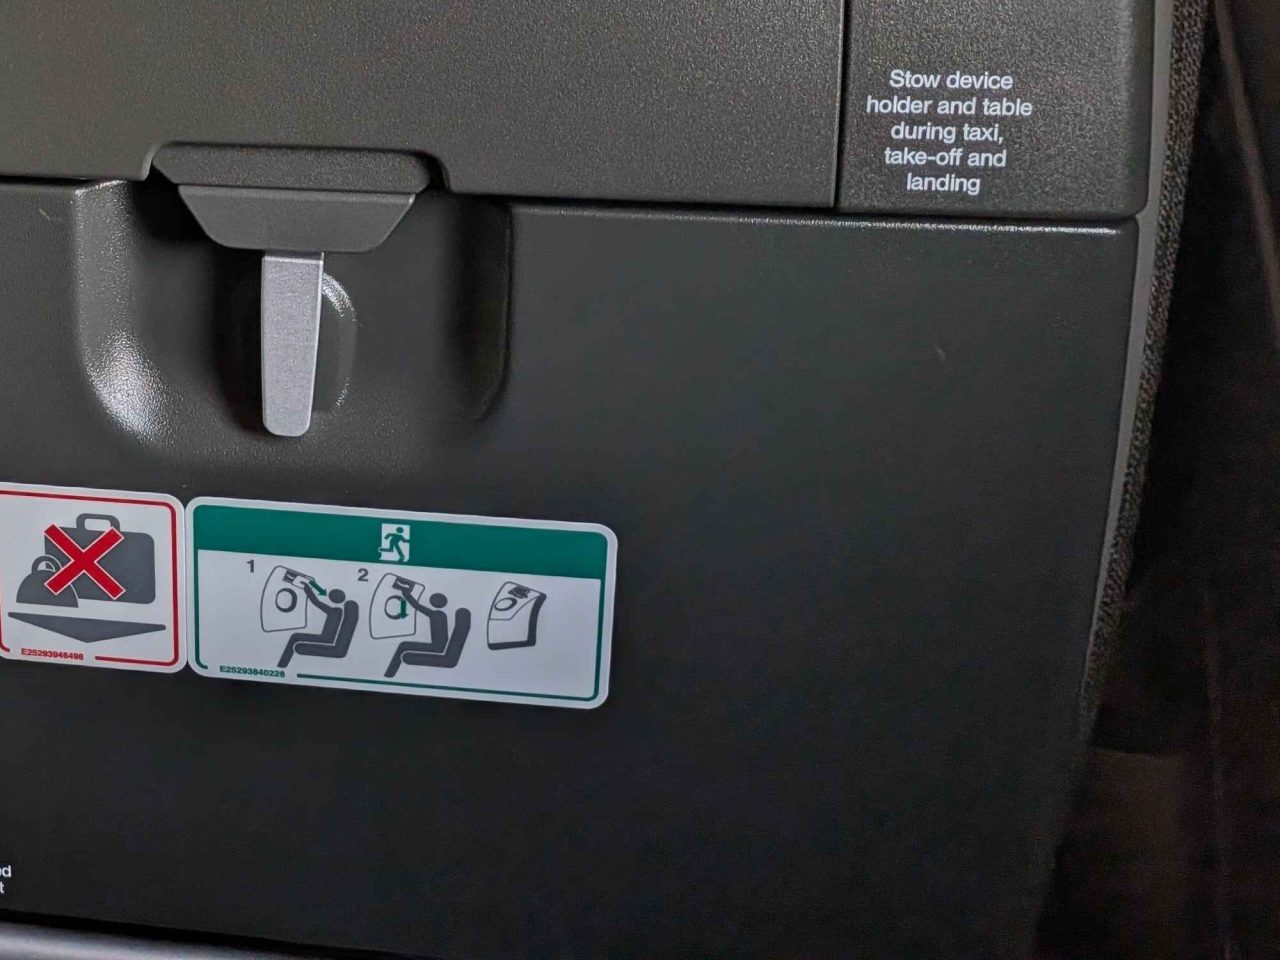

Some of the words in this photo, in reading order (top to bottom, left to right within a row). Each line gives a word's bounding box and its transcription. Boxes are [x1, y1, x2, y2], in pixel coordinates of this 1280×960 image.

[889, 69, 940, 88] Stow
[946, 71, 1013, 89] device
[866, 95, 932, 114] holder
[937, 97, 976, 115] and
[983, 98, 1033, 117] table
[890, 121, 956, 144] during
[963, 123, 1004, 145] taxi,
[884, 147, 963, 165] take-off
[967, 149, 1007, 167] and
[906, 173, 981, 196] landing
[246, 559, 255, 573] 1
[357, 568, 369, 582] 2
